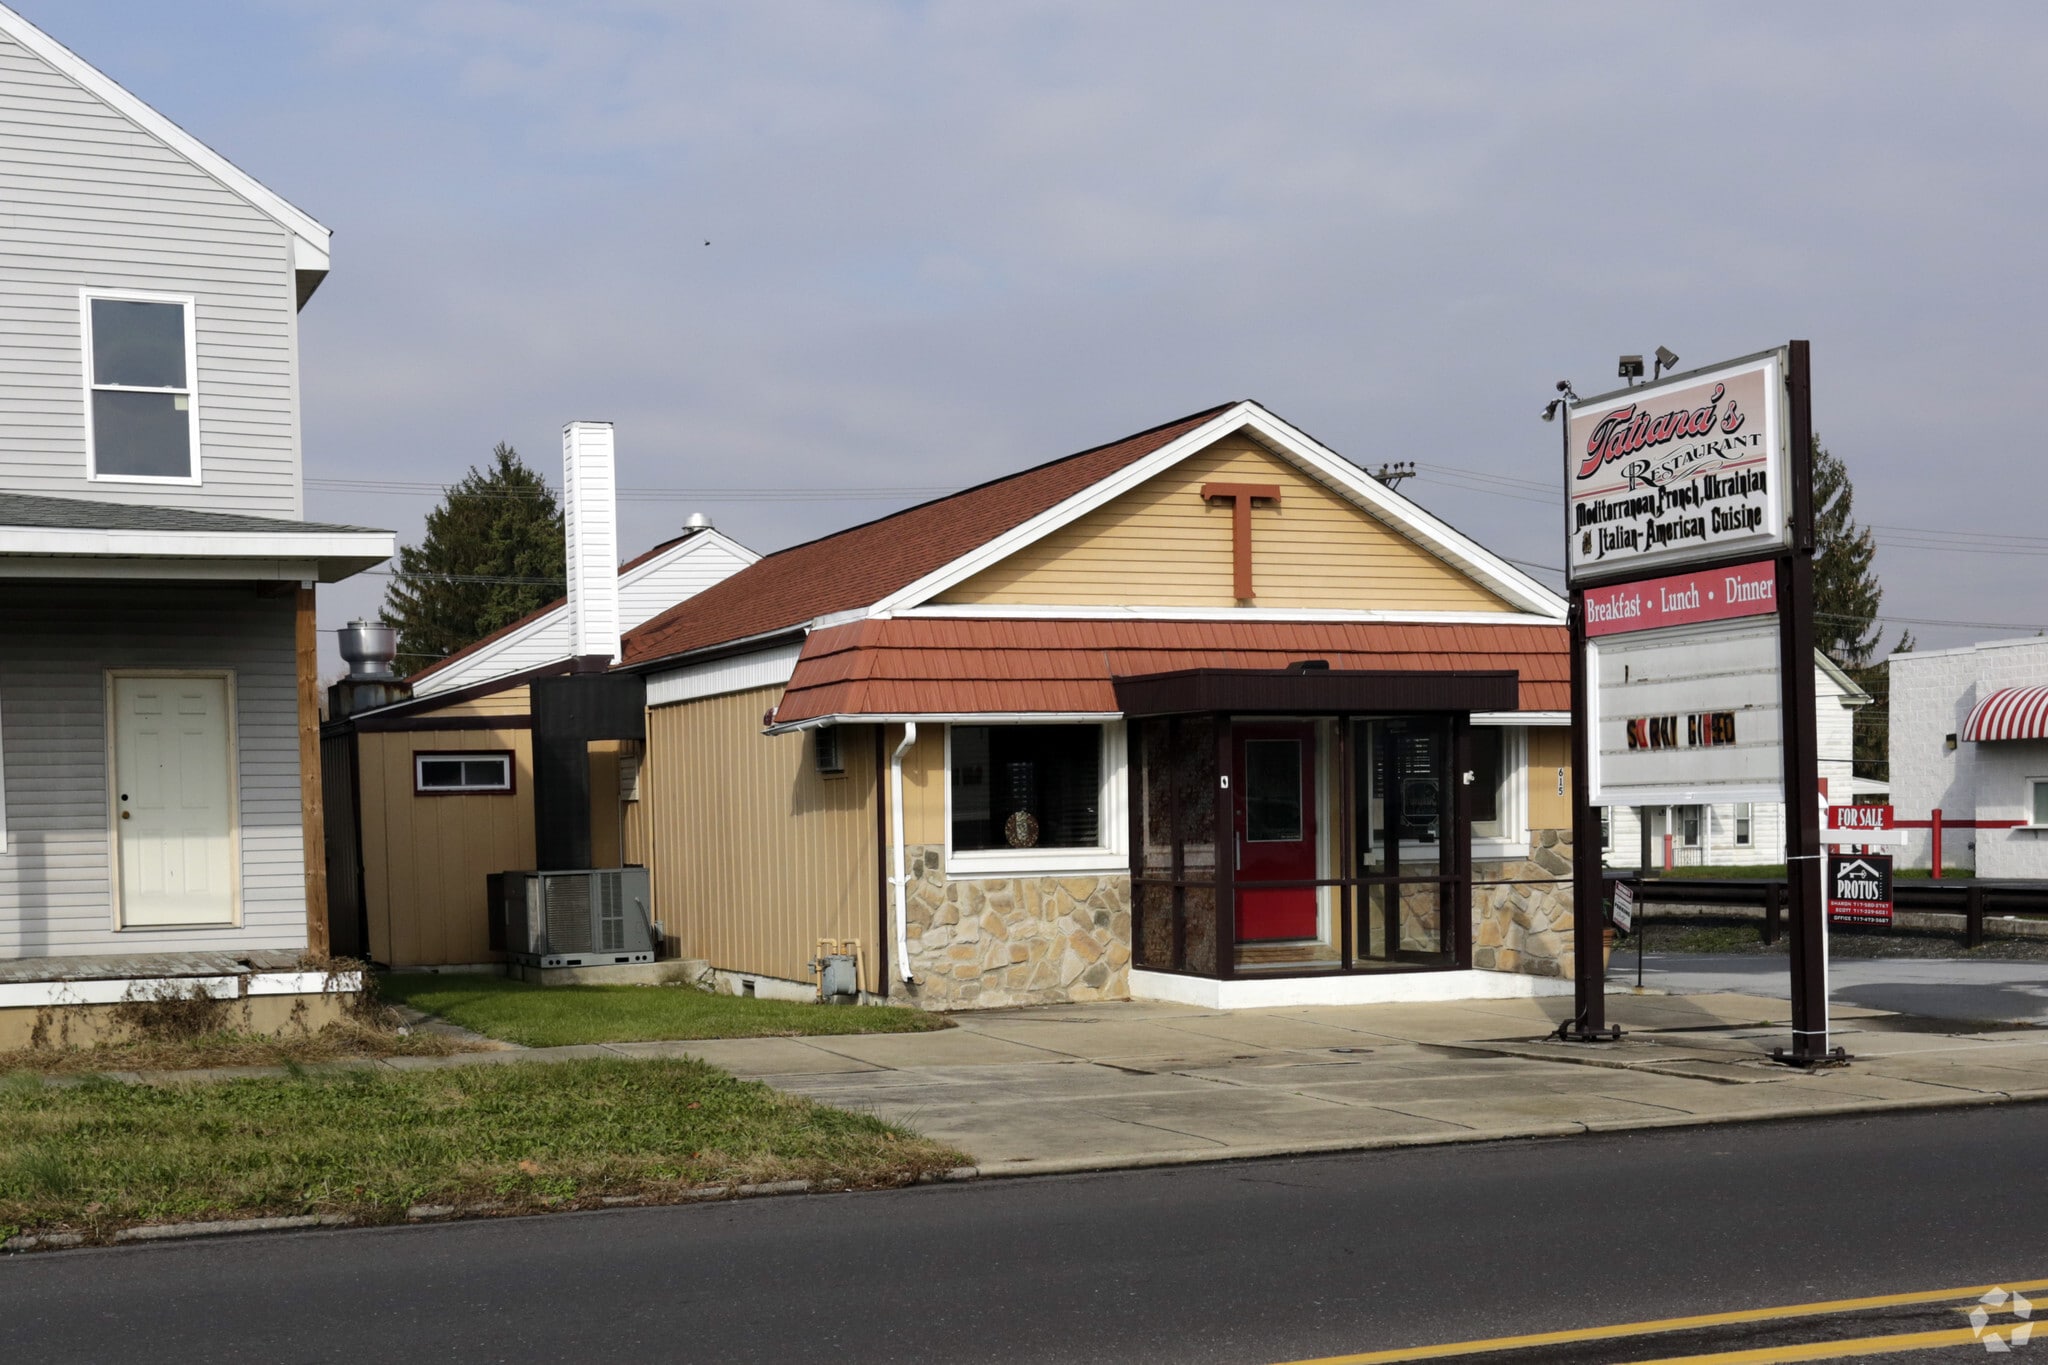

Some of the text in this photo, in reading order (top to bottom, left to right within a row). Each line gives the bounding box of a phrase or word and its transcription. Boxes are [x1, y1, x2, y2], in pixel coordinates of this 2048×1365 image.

[1576, 383, 1745, 479] Tatiana's
[1703, 468, 1767, 501] Ukrainian
[1201, 482, 1281, 599] T
[1595, 517, 1706, 560] Italian-American
[1711, 503, 1762, 535] Cuisine
[1587, 576, 1774, 623] Breakfast Lunch Dinner
[1557, 767, 1565, 796] 615
[1837, 808, 1884, 826] FOR SALE
[1837, 879, 1879, 900] PROTUS
